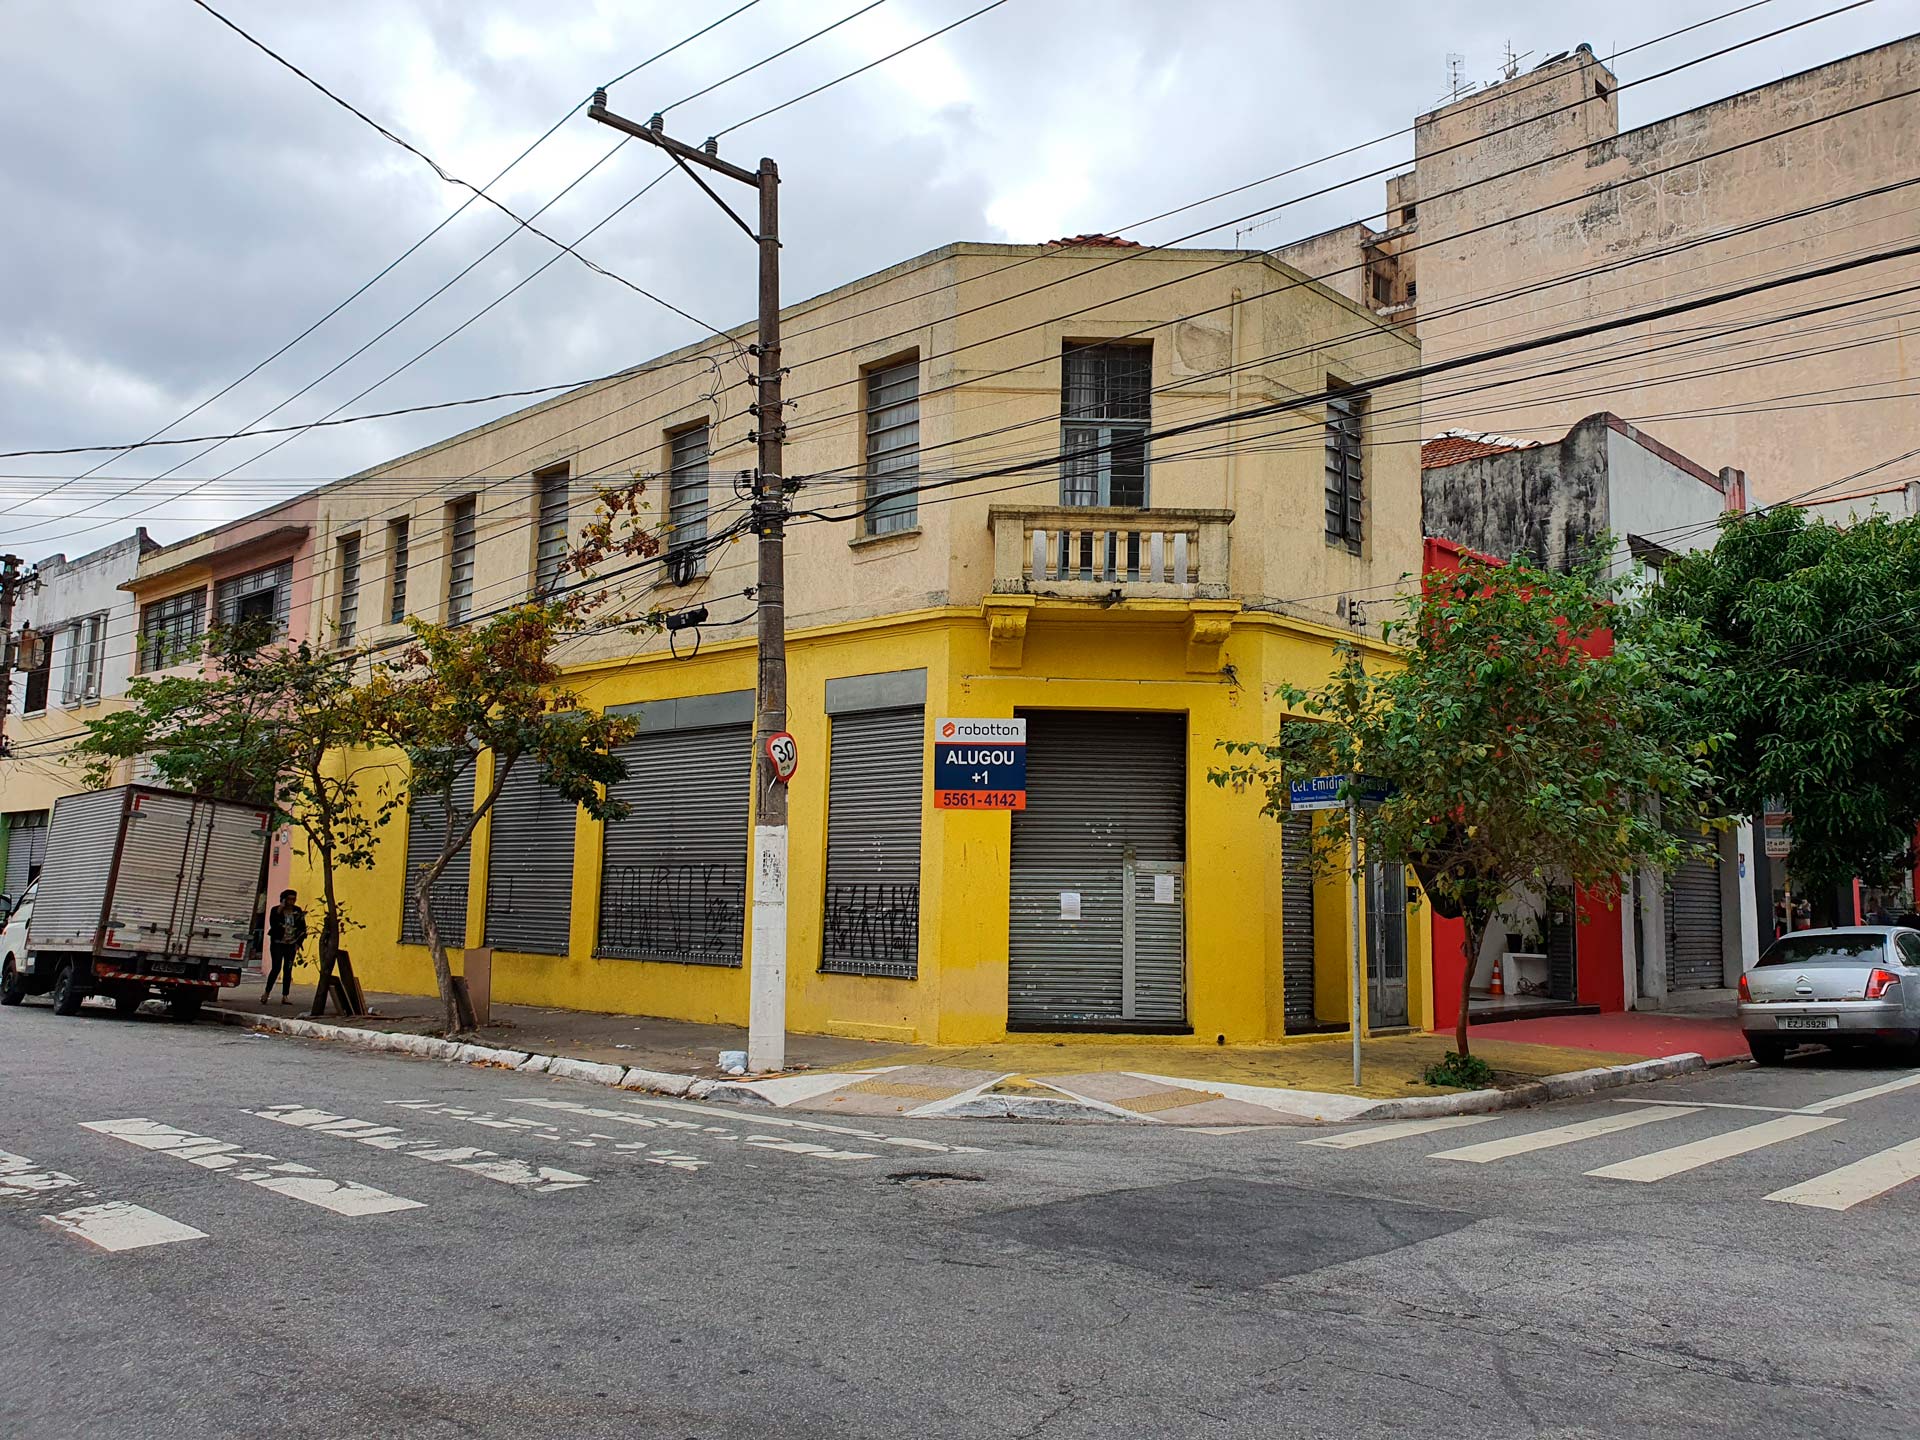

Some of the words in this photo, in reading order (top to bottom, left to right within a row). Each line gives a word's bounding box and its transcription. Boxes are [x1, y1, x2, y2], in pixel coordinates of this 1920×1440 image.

[958, 723, 1019, 736] robotton
[772, 740, 795, 763] 30
[945, 750, 1015, 765] ALUGOU
[971, 770, 988, 785] +1
[943, 792, 1016, 807] 5561-4142
